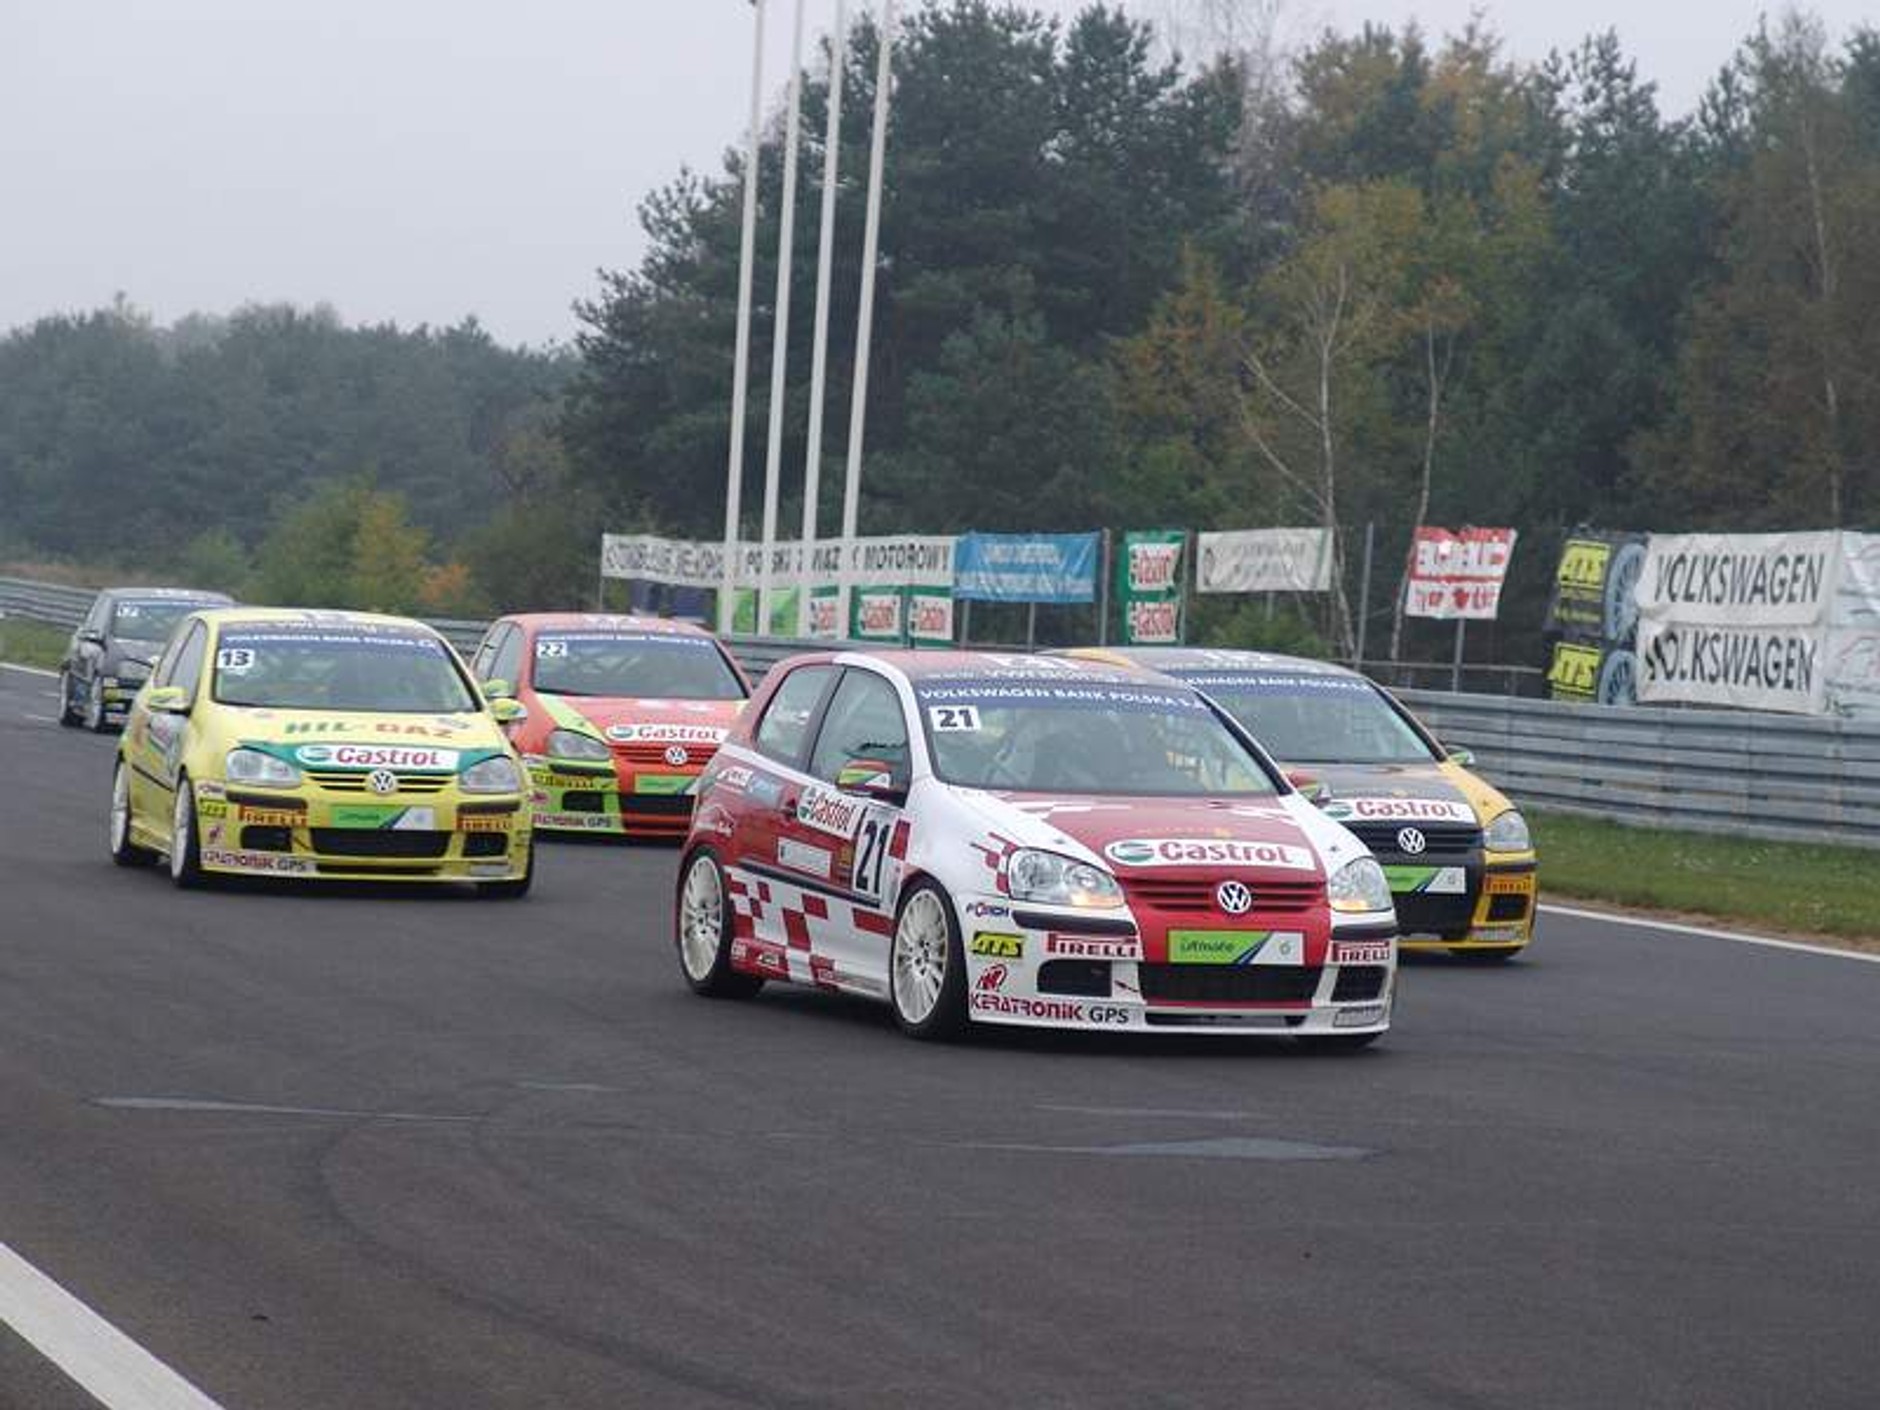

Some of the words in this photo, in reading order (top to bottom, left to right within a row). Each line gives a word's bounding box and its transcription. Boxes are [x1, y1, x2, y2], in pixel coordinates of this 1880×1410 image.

[1654, 553, 1825, 605] VOLKSWAGEN
[539, 642, 564, 656] 22
[221, 652, 249, 667] 13
[1645, 631, 1818, 696] VOLKSWAGEN
[919, 688, 1050, 699] VOLKSWAGEN
[1054, 687, 1106, 700] BANK
[937, 709, 974, 727] 21
[638, 725, 720, 741] Castrol
[336, 747, 441, 765] Castrol
[1355, 801, 1461, 817] Castrol
[855, 819, 891, 895] 21
[1158, 841, 1293, 863] Castrol
[277, 857, 307, 873] GPS
[1047, 932, 1137, 958] PIRELLI
[1333, 940, 1391, 963] PIRELLI
[1088, 1005, 1130, 1024] GPS
